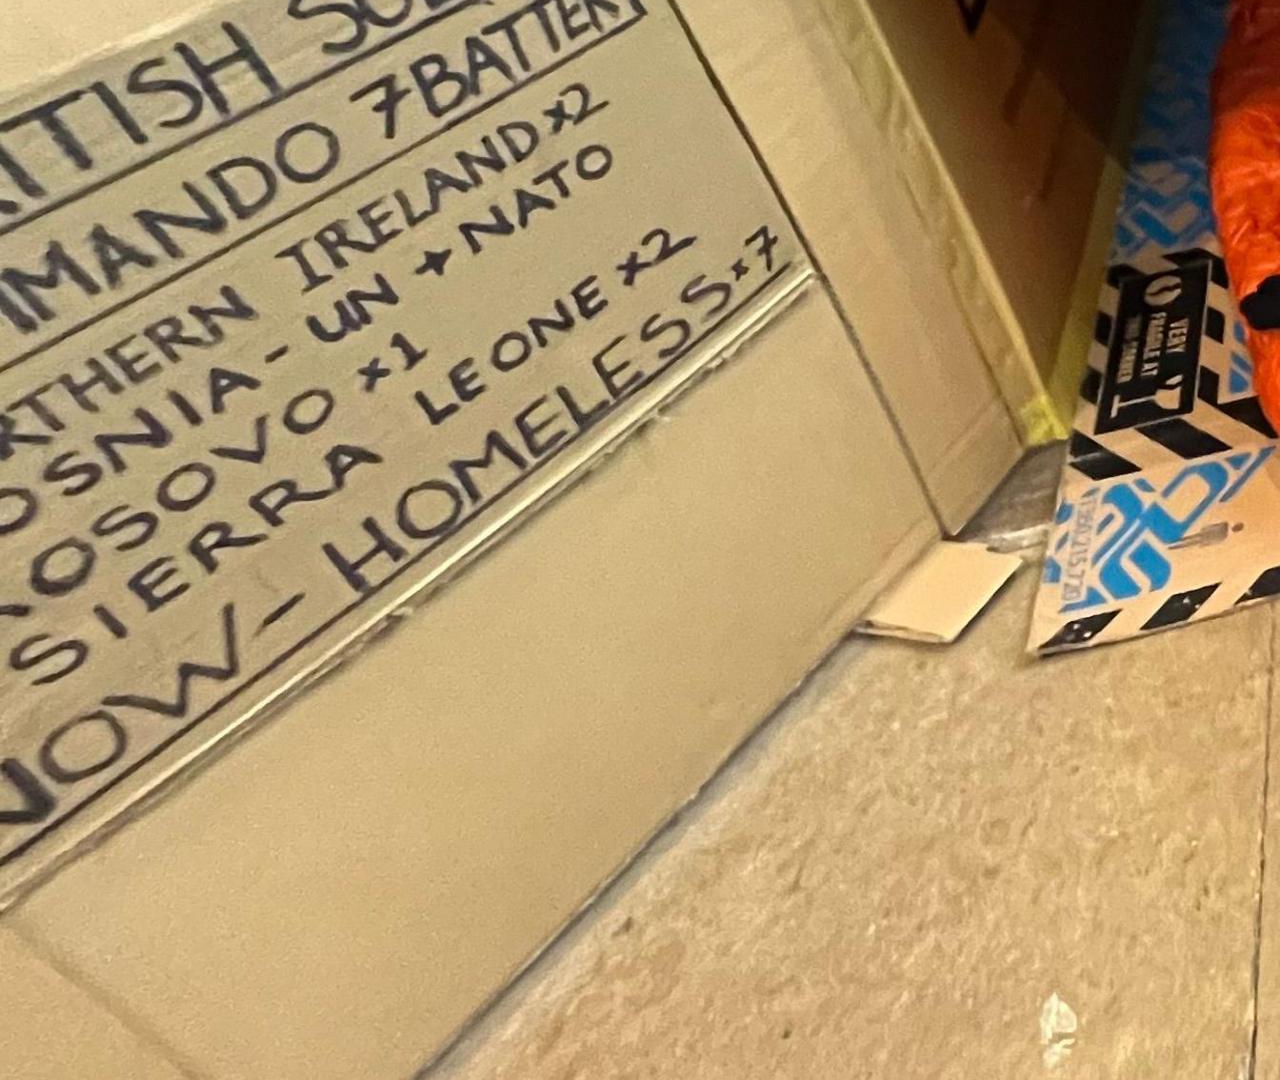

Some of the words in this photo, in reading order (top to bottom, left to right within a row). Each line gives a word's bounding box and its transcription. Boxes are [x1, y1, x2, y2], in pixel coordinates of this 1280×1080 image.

[0, 23, 278, 213] ITISH
[276, 120, 540, 292] IRELAND
[306, 272, 400, 344] UN
[458, 143, 613, 255] NATO
[1166, 317, 1190, 354] VERY
[9, 442, 383, 686] SIERRA
[414, 275, 607, 427] LEONE
